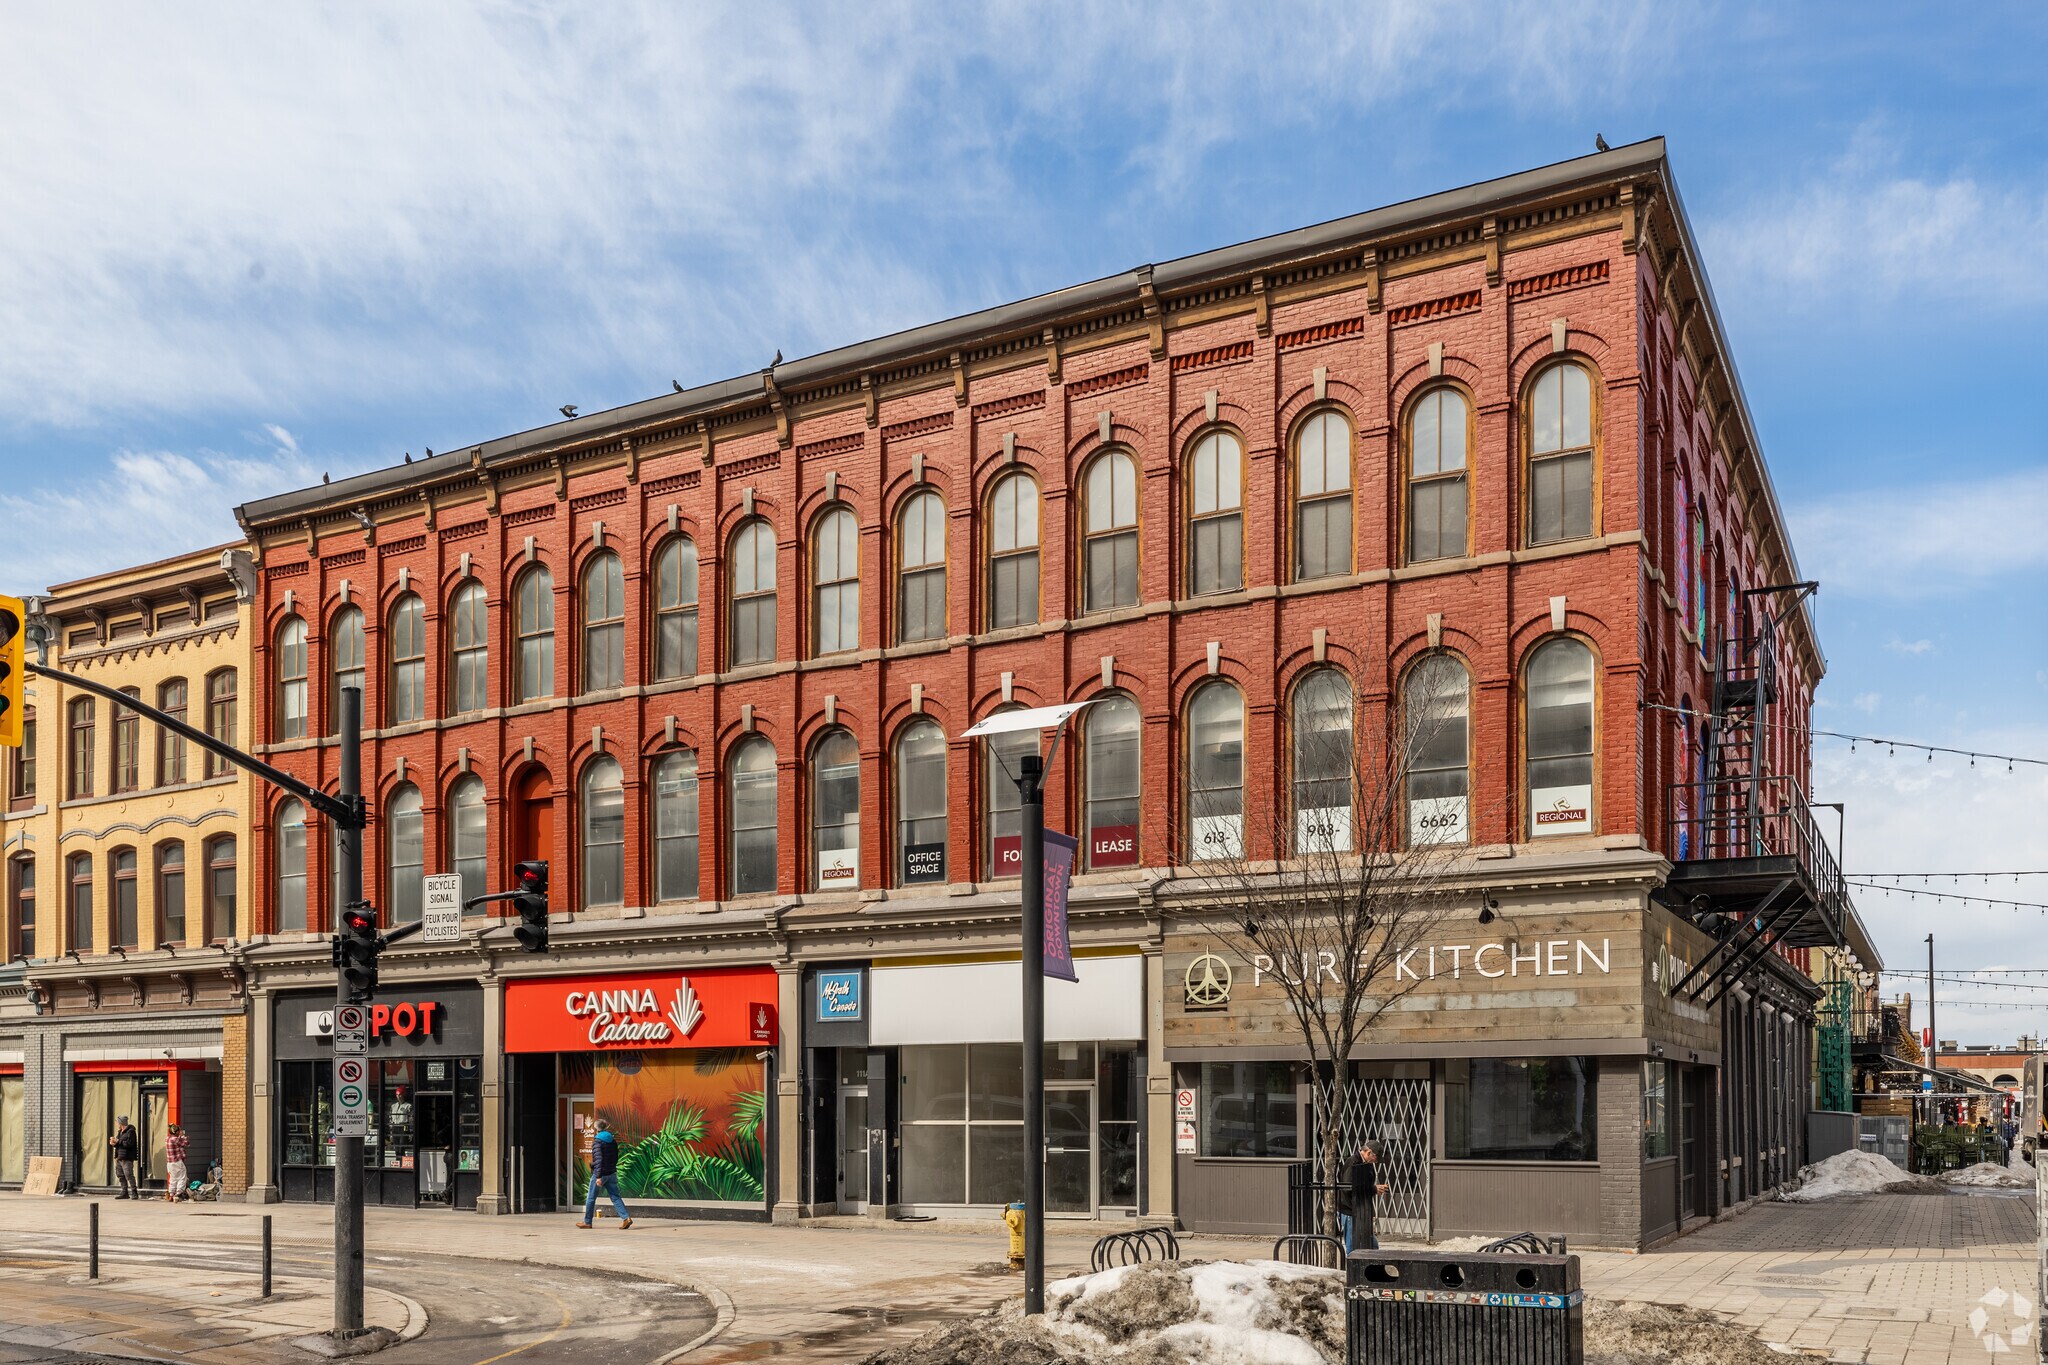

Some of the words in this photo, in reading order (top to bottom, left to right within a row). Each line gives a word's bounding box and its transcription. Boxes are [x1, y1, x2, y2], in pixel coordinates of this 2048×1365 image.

[1420, 813, 1458, 828] 6662
[1539, 811, 1583, 822] REGIONAL
[1095, 839, 1132, 853] LEASE
[908, 851, 941, 863] OFFICE
[824, 867, 852, 878] REGIONAL
[910, 863, 939, 875] SPACE
[428, 880, 456, 891] BICYCLE
[430, 893, 454, 904] SIGNAL
[1045, 862, 1057, 958] ORIGINAL
[1054, 863, 1064, 960] DOWNTOWN
[425, 914, 441, 924] FEUX
[442, 912, 459, 923] POUR
[426, 926, 458, 937] CYCLISTES
[1396, 938, 1610, 982] KITCHEN
[566, 988, 660, 1016] CANNA
[829, 998, 857, 1012] Canada
[371, 1001, 437, 1037] POT
[588, 1011, 672, 1044] Cabana
